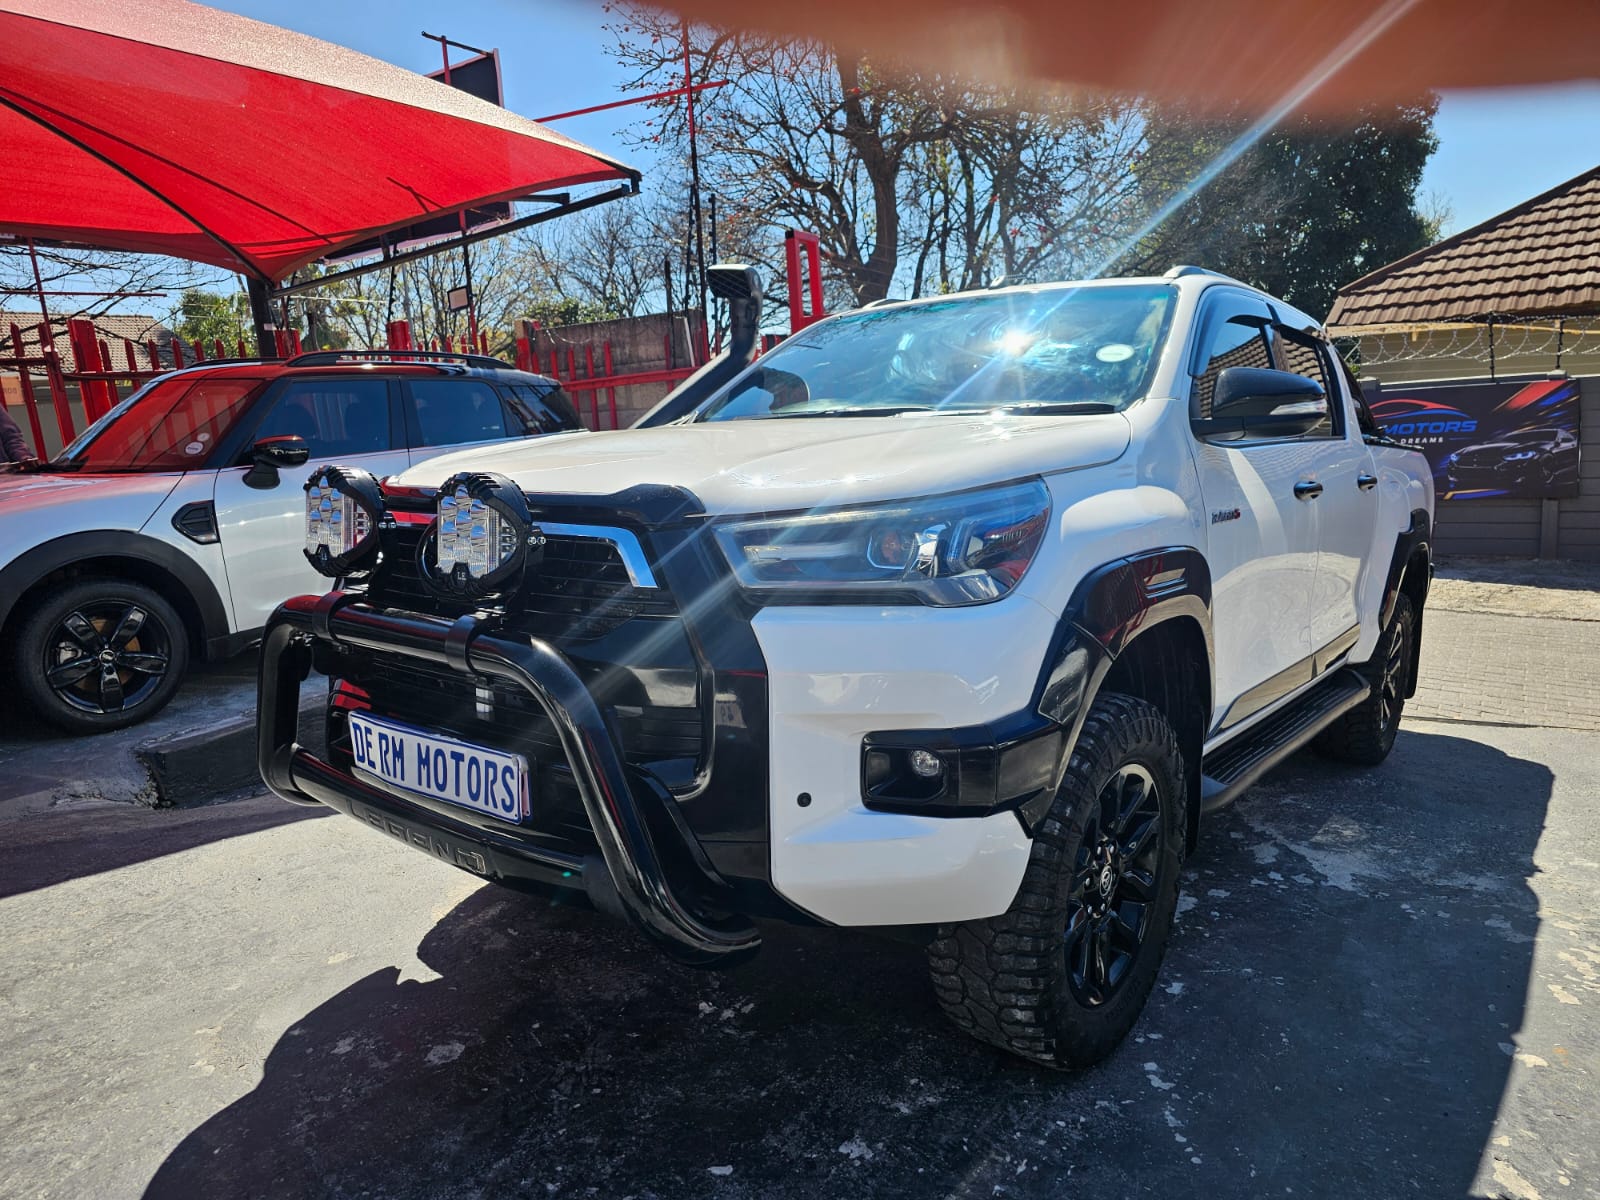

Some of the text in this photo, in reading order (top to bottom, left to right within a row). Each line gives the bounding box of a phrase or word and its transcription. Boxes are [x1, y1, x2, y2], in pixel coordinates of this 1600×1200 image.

[1384, 420, 1478, 435] MOTORS
[1400, 437, 1444, 445] DREAMS
[352, 722, 515, 813] DE RM MOTORS
[346, 798, 487, 875] LEGEND
